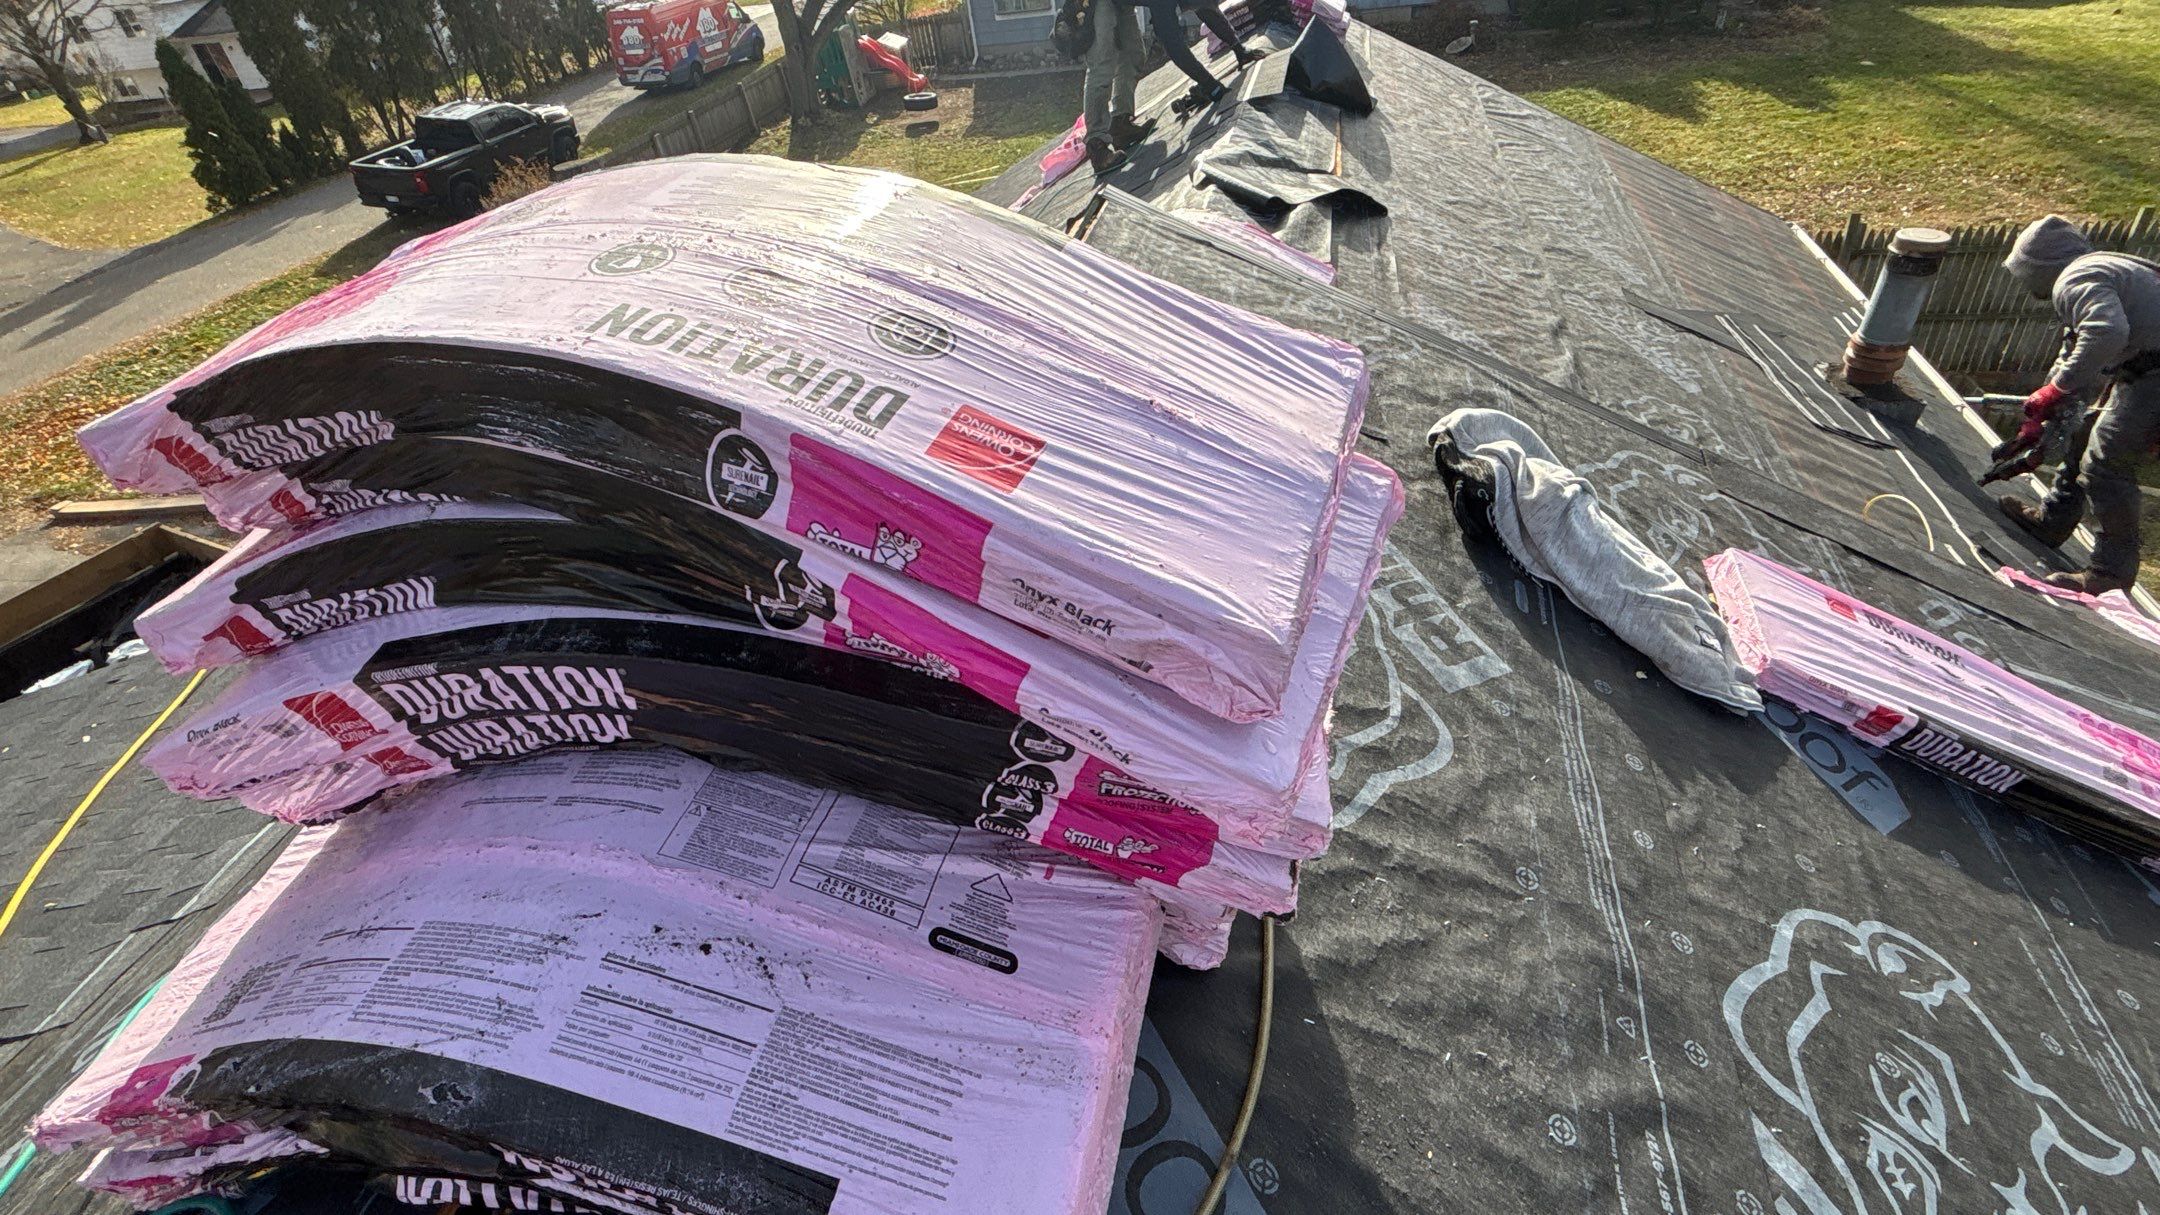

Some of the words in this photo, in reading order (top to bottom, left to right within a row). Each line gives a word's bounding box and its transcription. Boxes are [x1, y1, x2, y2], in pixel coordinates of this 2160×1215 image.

[584, 303, 910, 430] DURATION
[952, 422, 1015, 457] OWENS
[959, 413, 1035, 454] CORNING
[1064, 602, 1117, 636] Black
[380, 666, 637, 723] DURATION
[1902, 729, 2028, 794] DURATION
[1003, 773, 1042, 792] CLASS
[1040, 780, 1057, 796] 3
[1073, 834, 1110, 851] TOTAL
[816, 882, 856, 902] ICC-ES
[860, 899, 896, 917] AC438
[824, 876, 856, 893] ASTM
[656, 1187, 682, 1202] TEJAS
